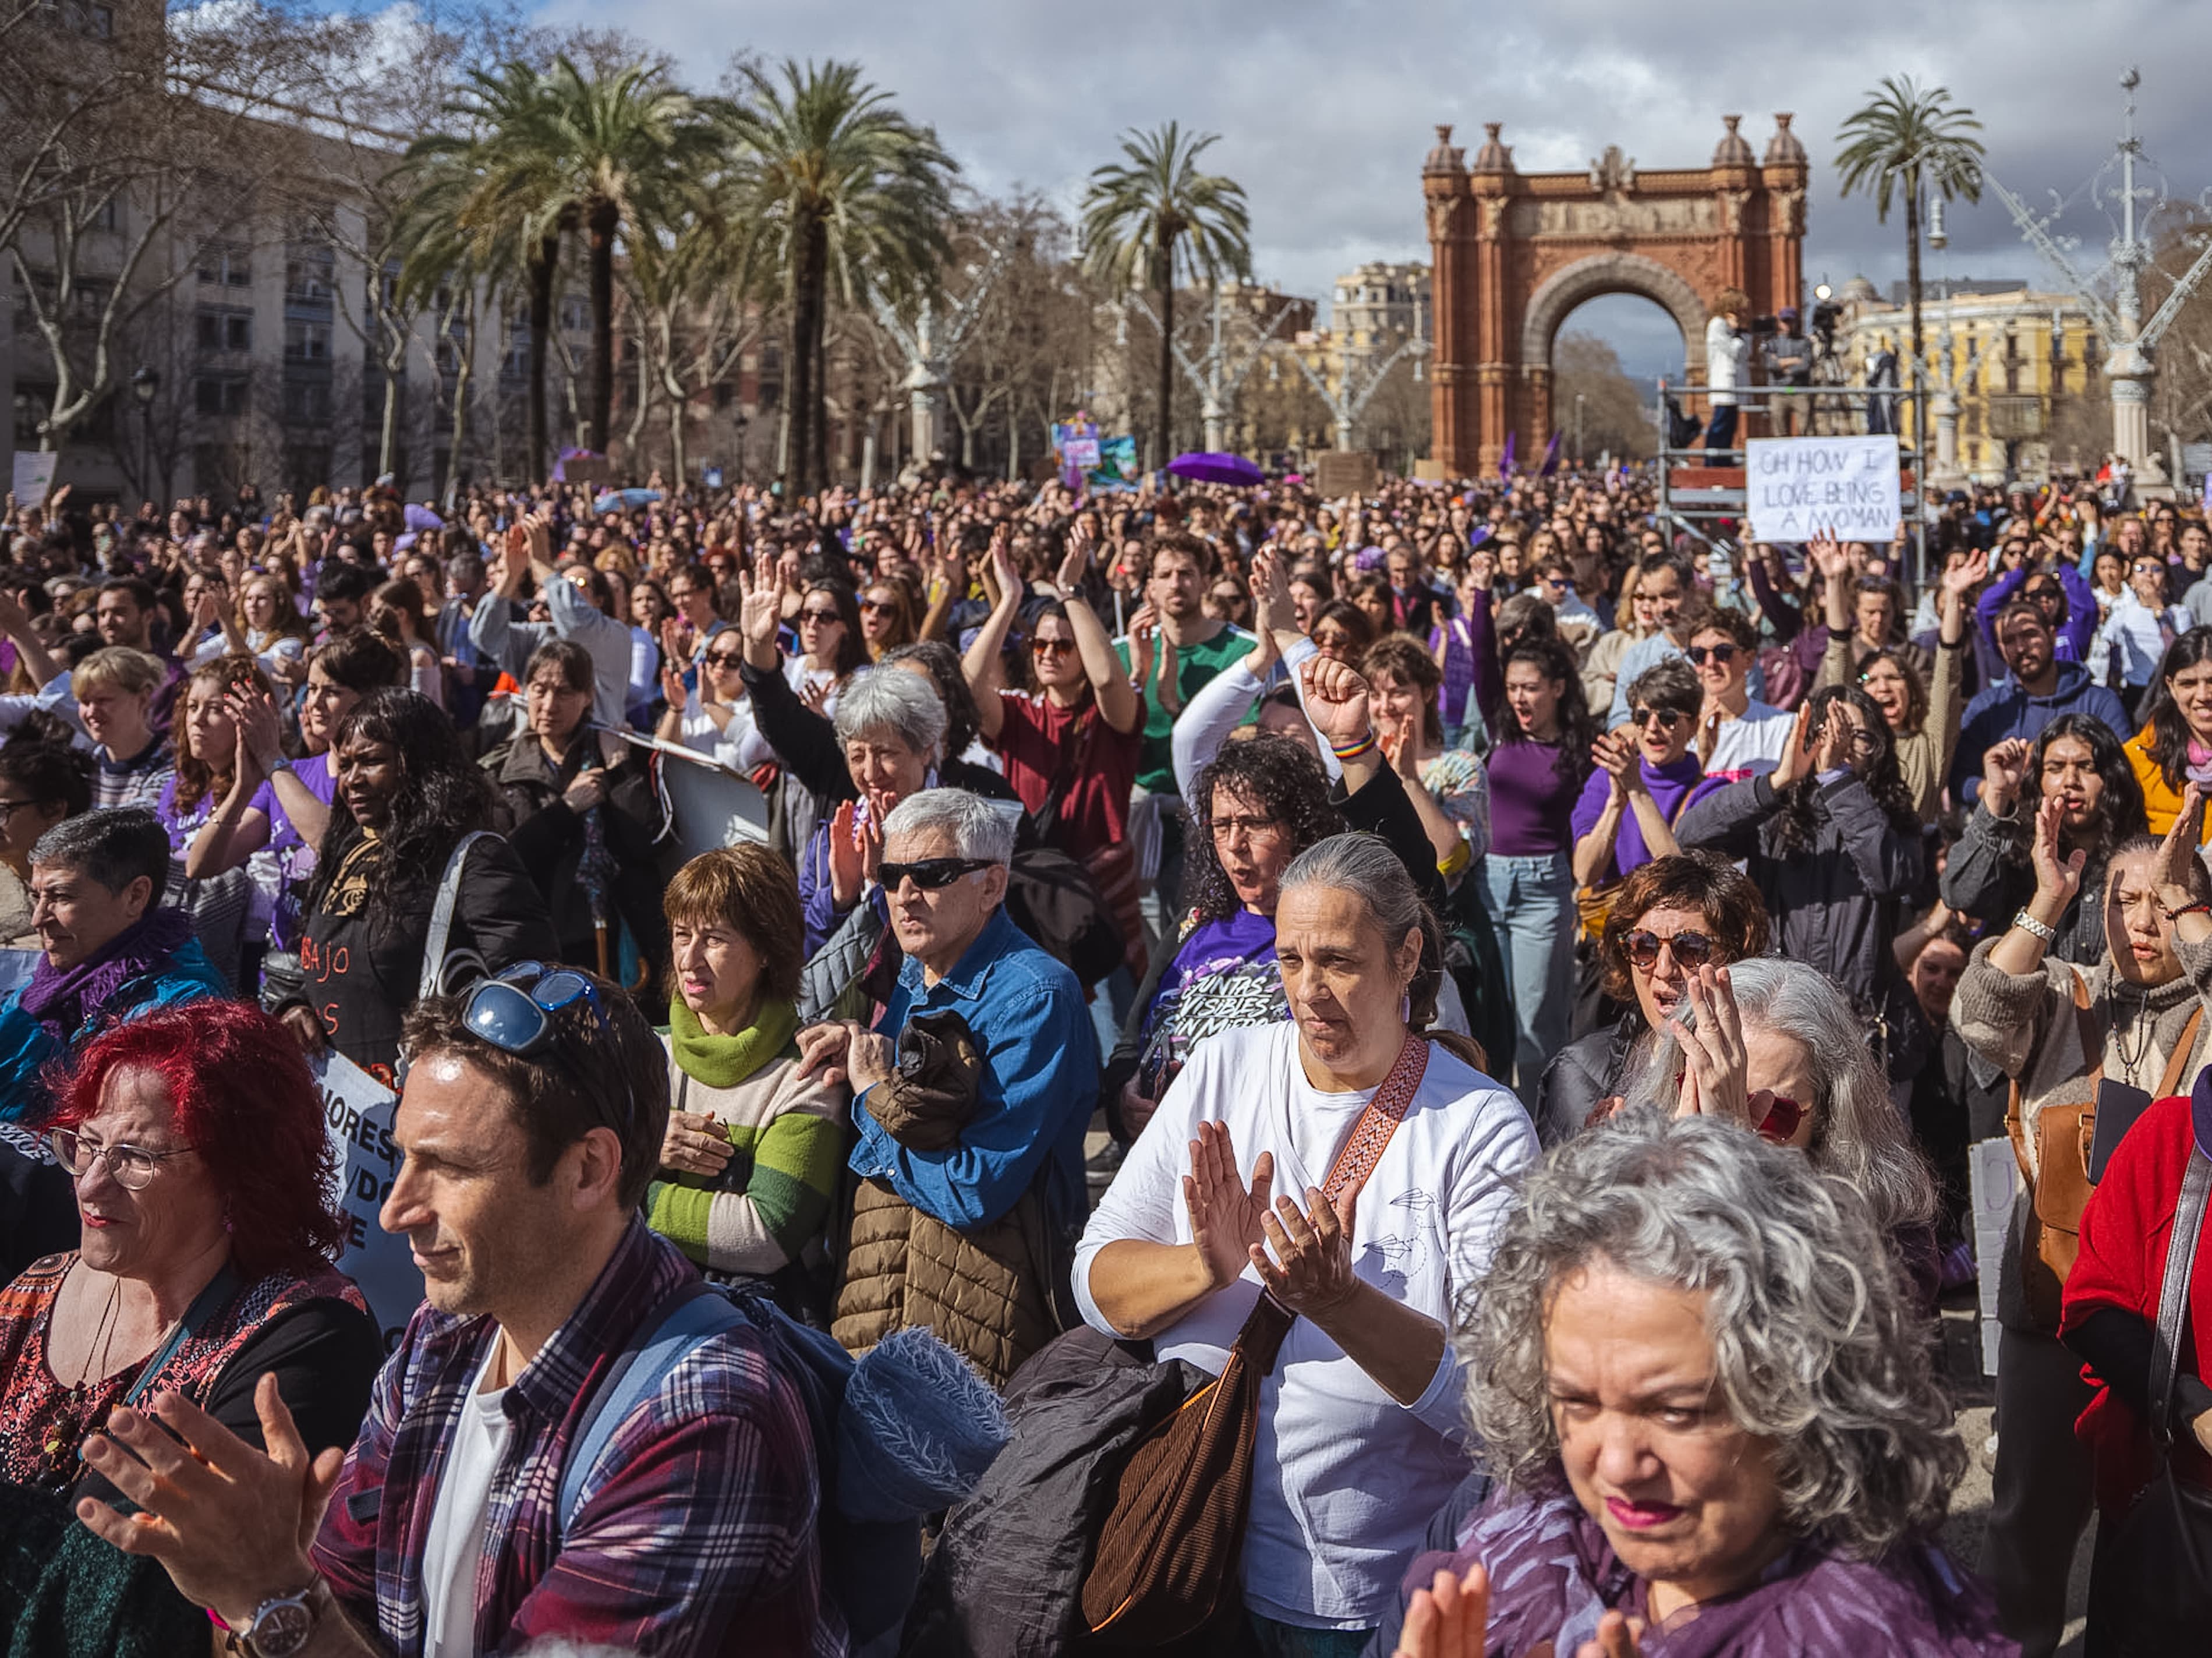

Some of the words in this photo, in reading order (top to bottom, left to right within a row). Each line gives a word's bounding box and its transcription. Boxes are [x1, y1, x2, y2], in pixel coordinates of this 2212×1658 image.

[1760, 451, 1789, 475] OH
[1797, 449, 1848, 474] HOW
[1863, 450, 1877, 469] I
[1764, 483, 1817, 508] LOVE
[1826, 481, 1885, 505] BEING
[1781, 511, 1799, 530] A
[1181, 975, 1267, 1000] JUNTAS
